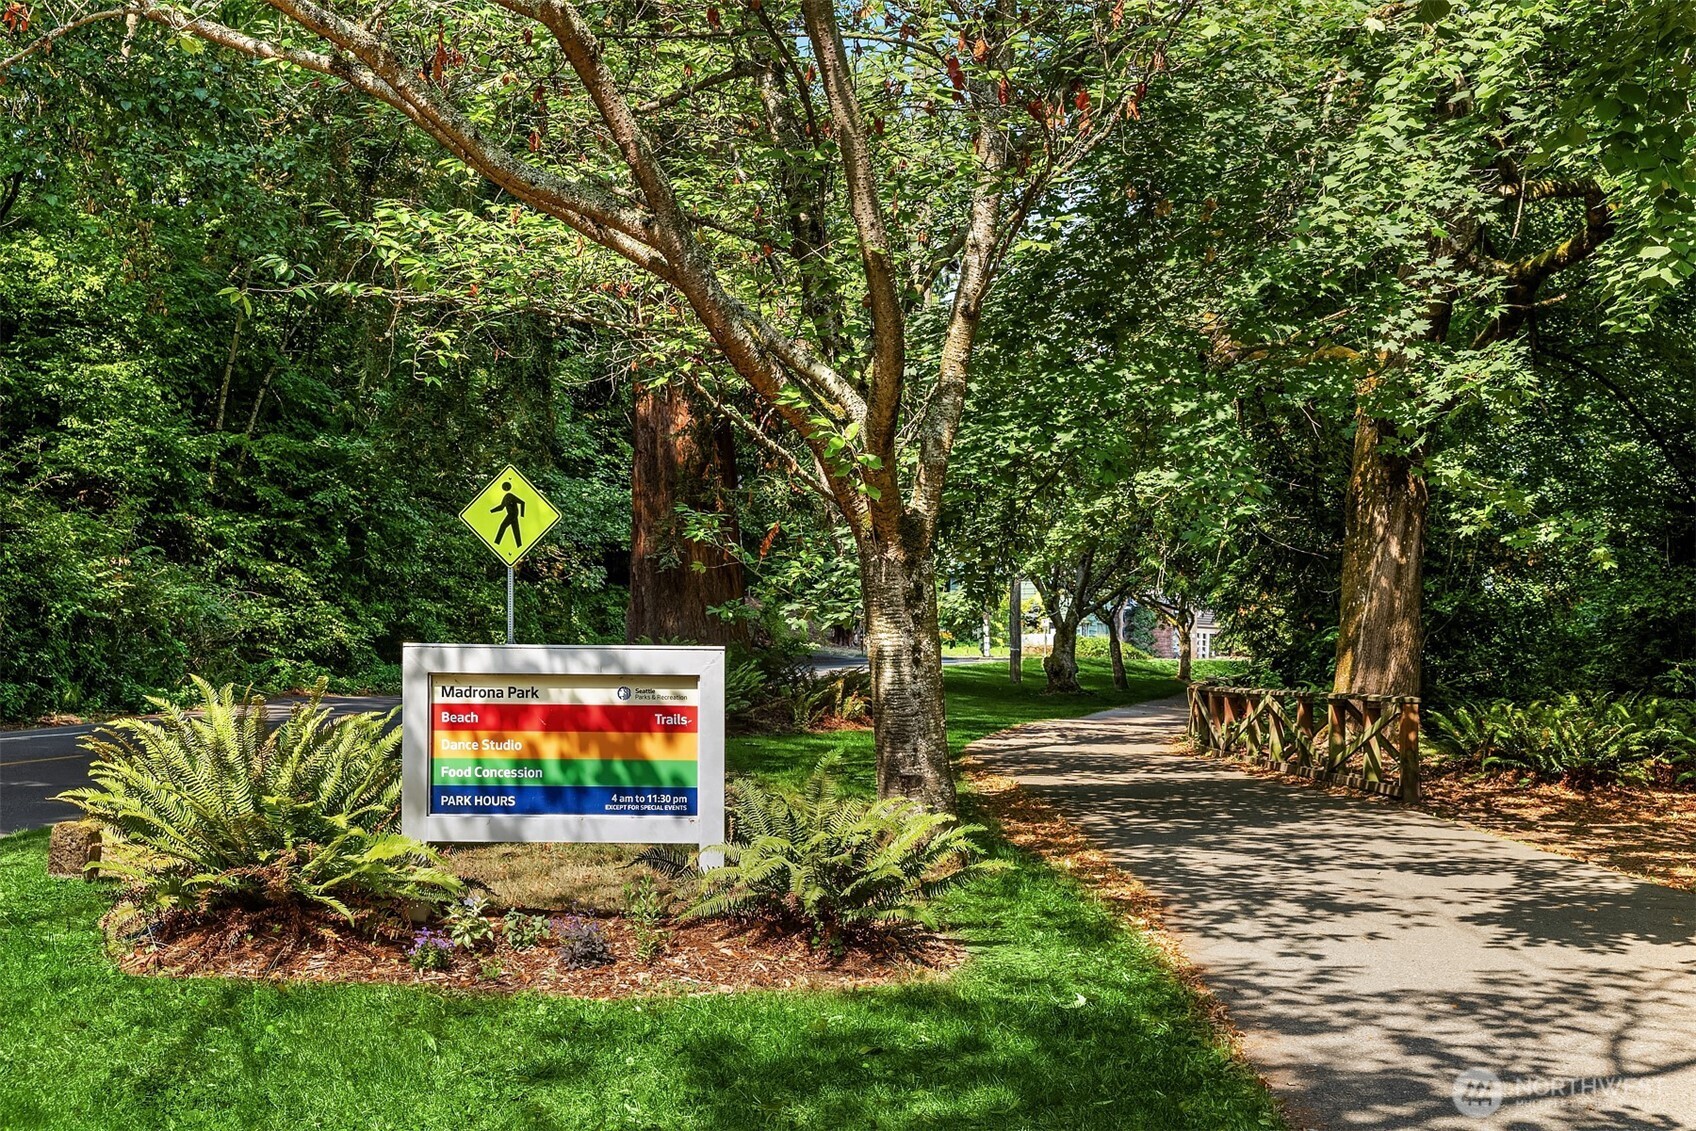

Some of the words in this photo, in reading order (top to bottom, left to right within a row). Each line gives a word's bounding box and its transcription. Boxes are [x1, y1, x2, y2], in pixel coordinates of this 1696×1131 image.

[441, 685, 504, 698] Madrona
[508, 686, 540, 699] Park
[441, 711, 479, 723] Beach
[441, 739, 479, 751] Dance
[481, 739, 523, 751] Studio
[441, 766, 472, 778] Food
[474, 766, 543, 778] Concession
[440, 795, 472, 806] PARK
[474, 795, 516, 807] HOURS
[611, 793, 618, 803] 4
[619, 795, 634, 803] am
[635, 794, 646, 803] to
[646, 794, 672, 803] 11:30
[672, 795, 688, 804] pm
